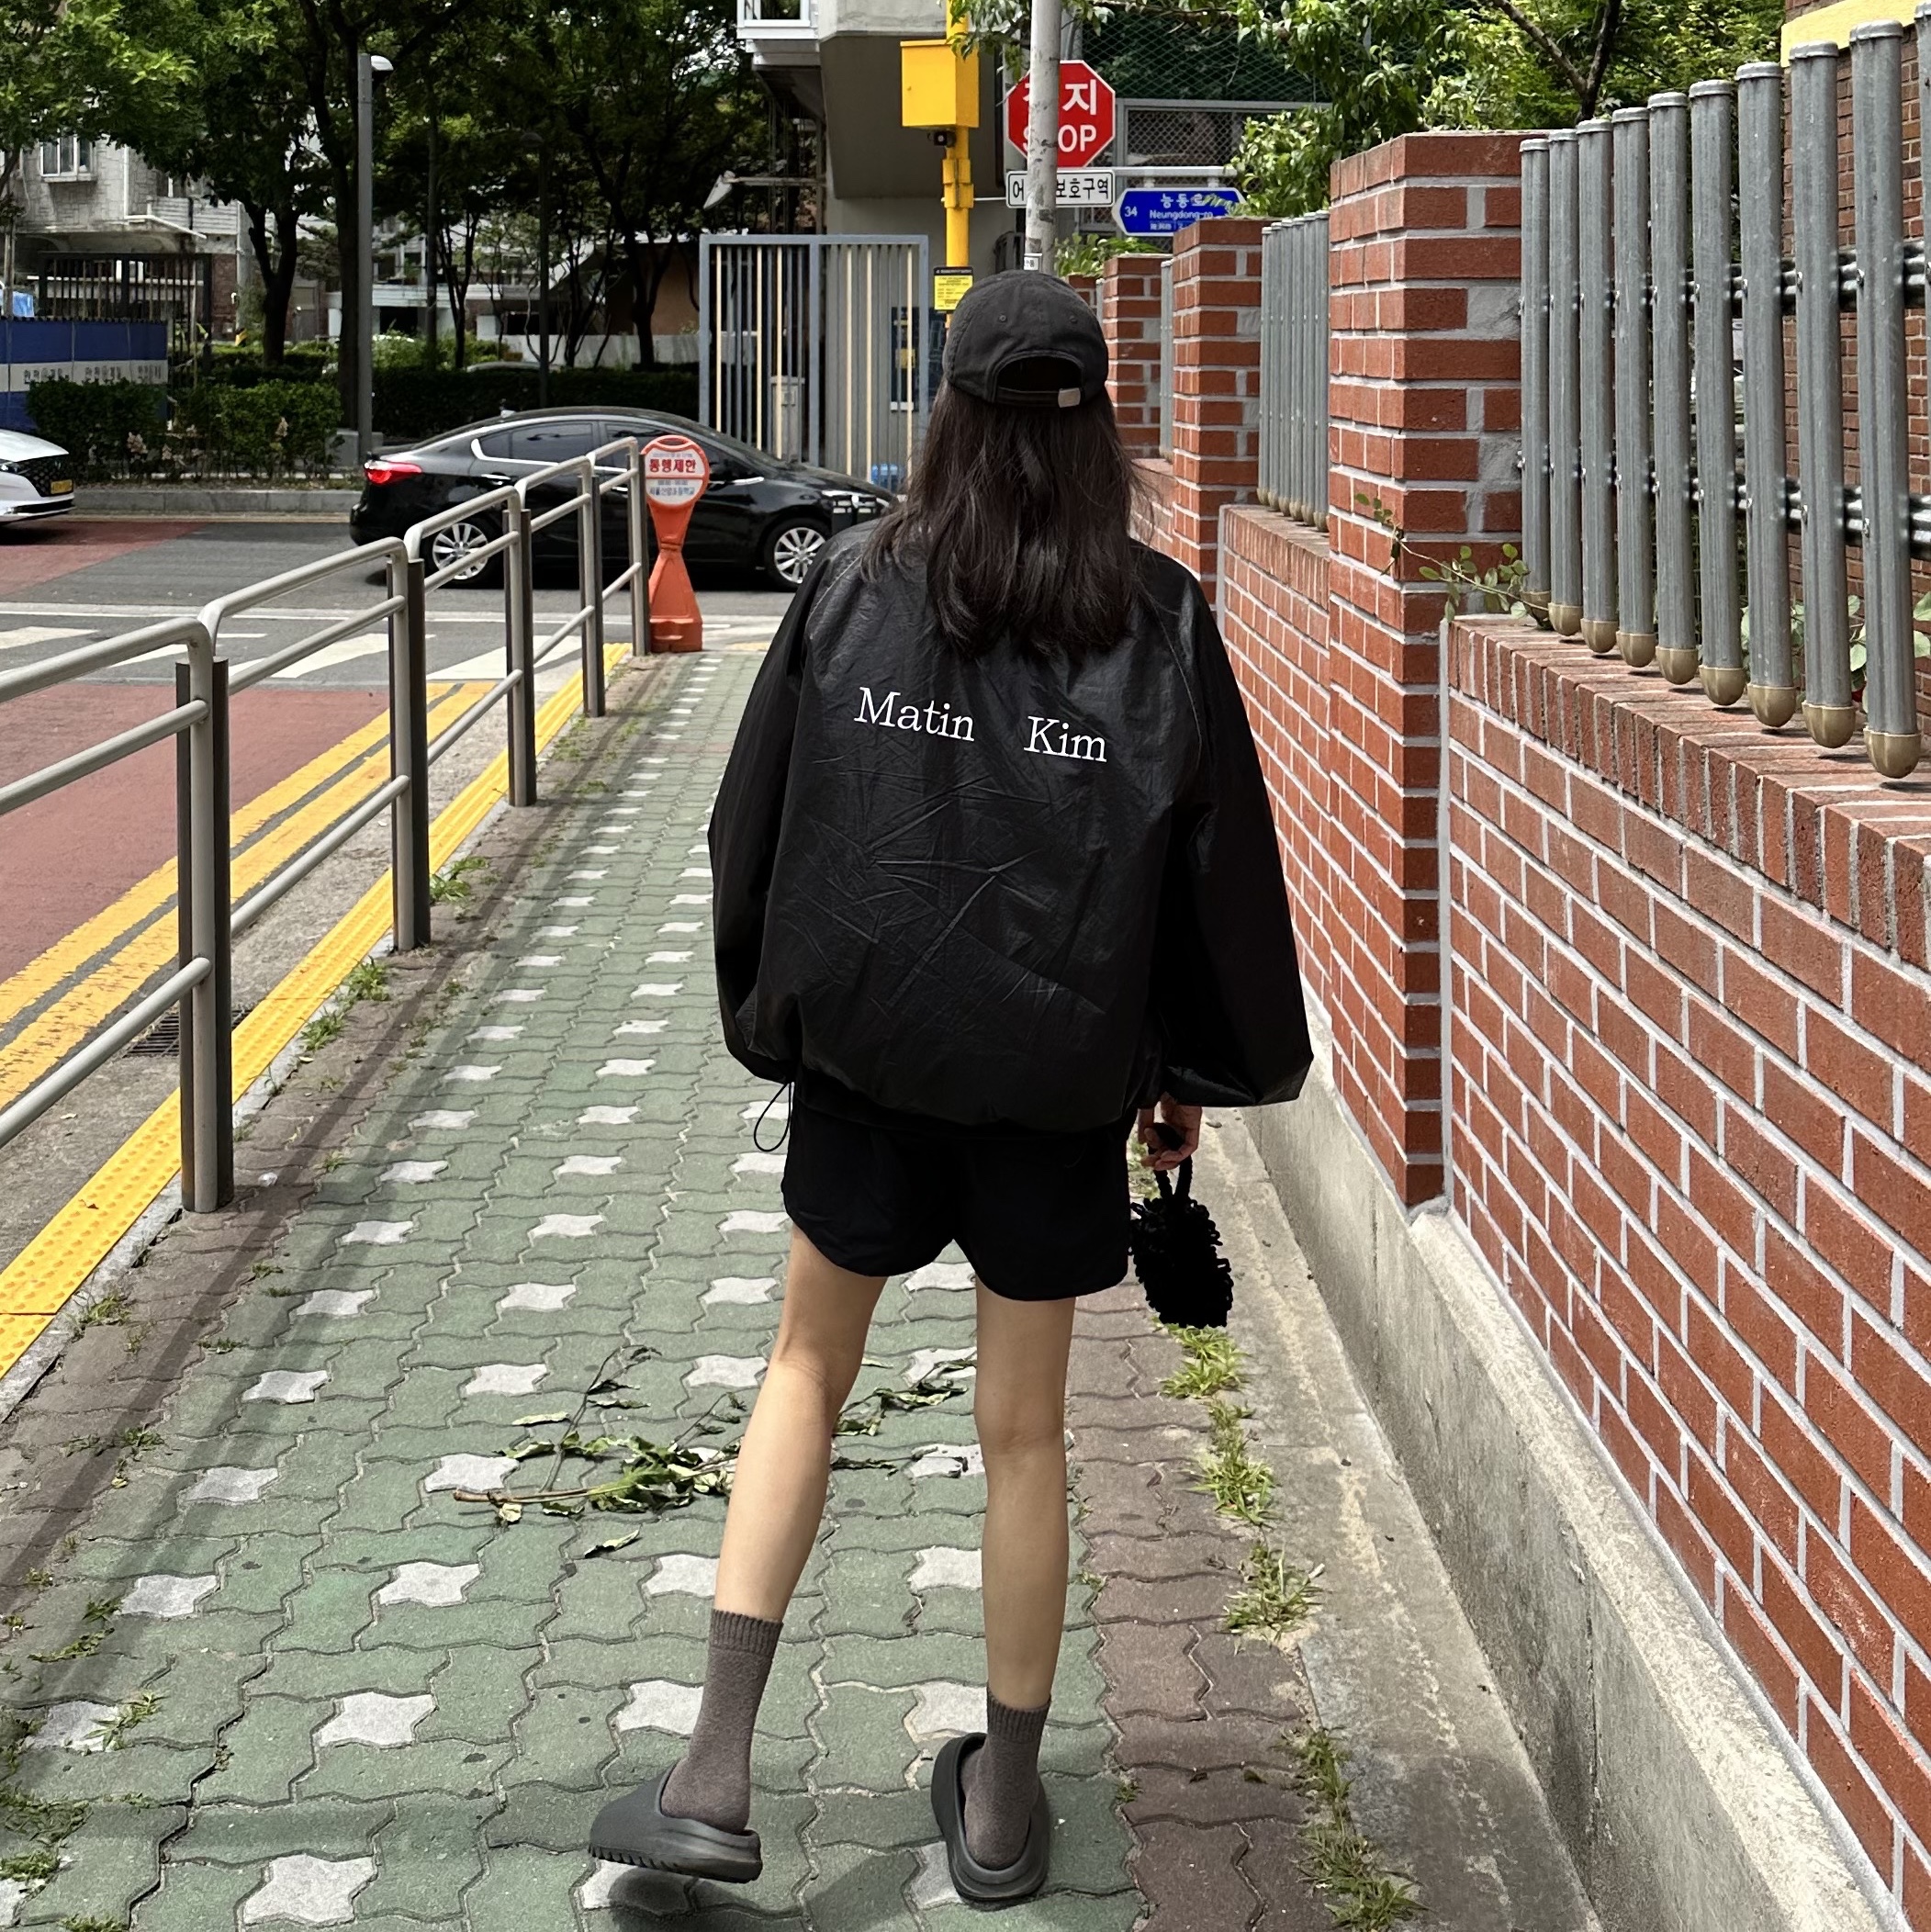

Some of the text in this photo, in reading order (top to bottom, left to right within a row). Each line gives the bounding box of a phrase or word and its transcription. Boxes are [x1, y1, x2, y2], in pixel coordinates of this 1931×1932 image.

[1023, 79, 1097, 116] 지
[1013, 178, 1108, 200] 어보호구역
[1161, 193, 1208, 209] 능동로
[1124, 206, 1138, 218] 34
[649, 458, 696, 473] 통행제한
[854, 687, 1107, 763] Matin Kim
